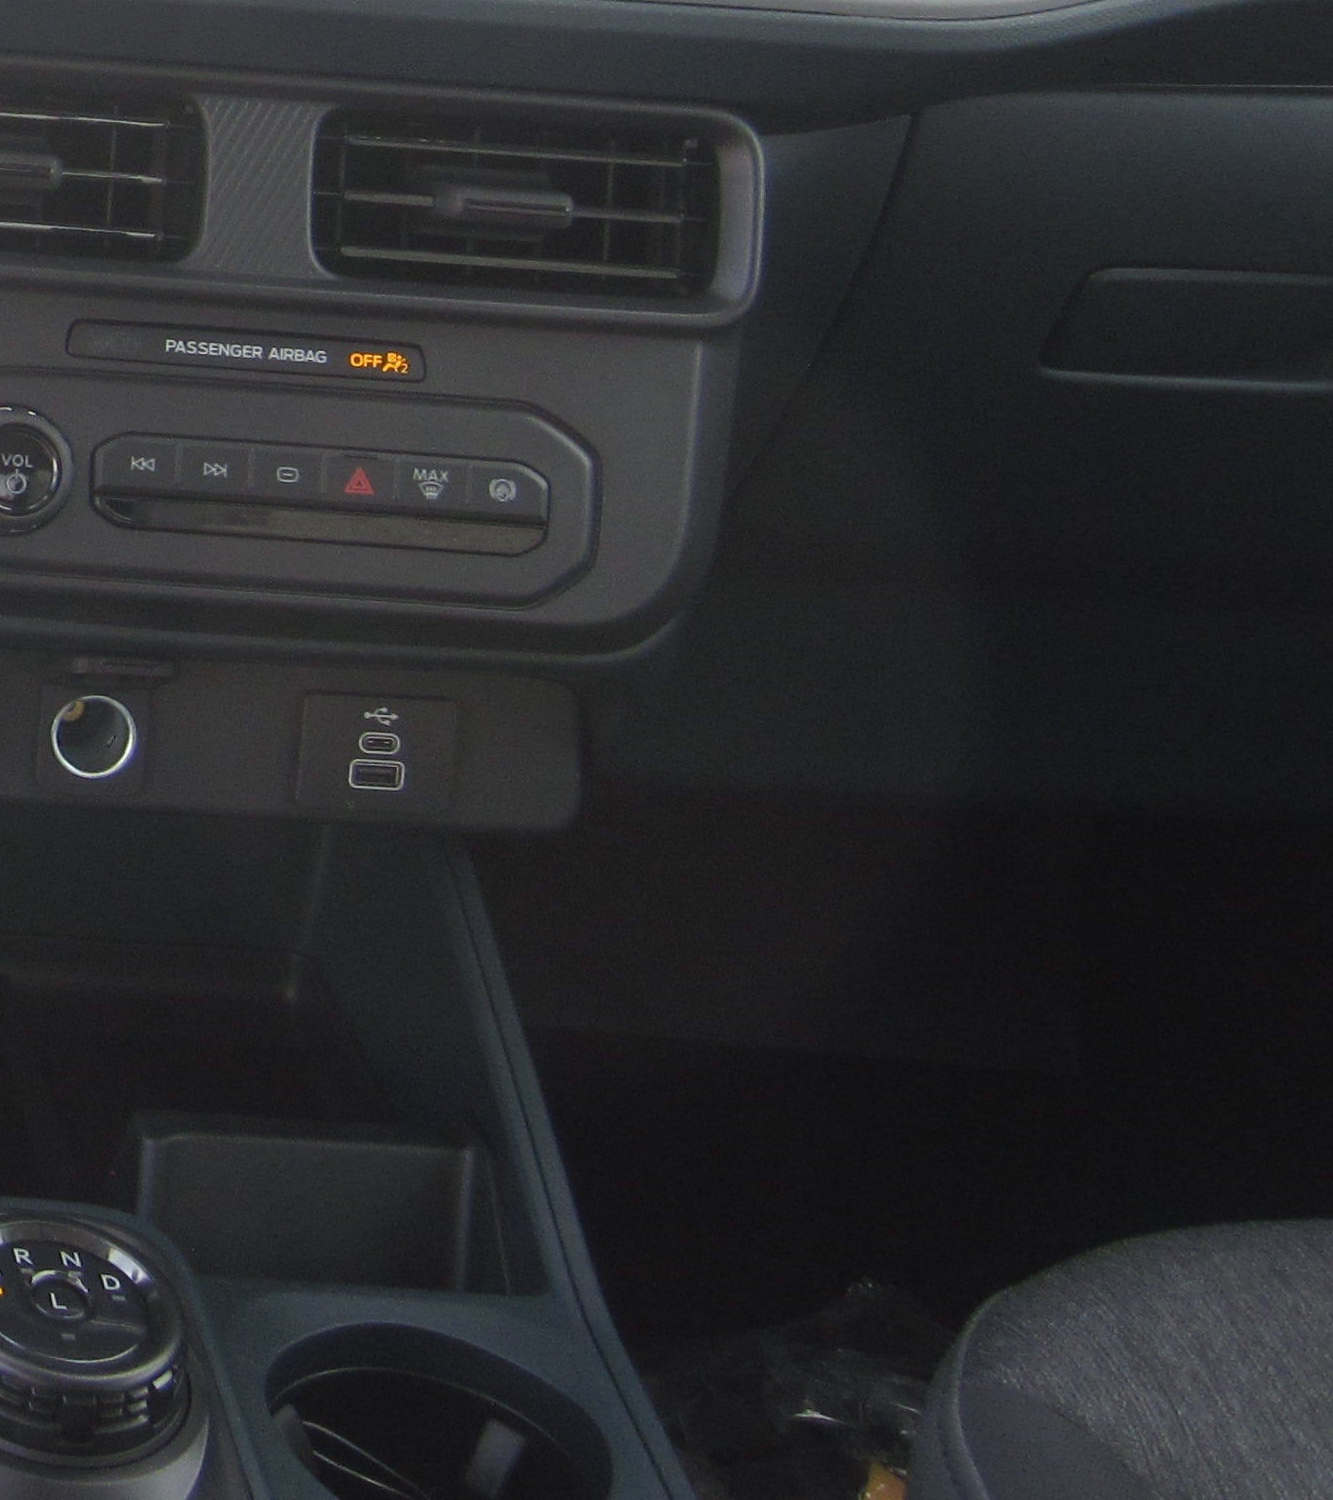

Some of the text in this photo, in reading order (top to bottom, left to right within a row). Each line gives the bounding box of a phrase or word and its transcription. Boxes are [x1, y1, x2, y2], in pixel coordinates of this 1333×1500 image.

[165, 338, 328, 364] PASSENGER AIRBAG
[349, 352, 382, 368] OFF
[1, 454, 34, 469] VOL
[413, 467, 450, 482] MAX
[14, 1247, 33, 1264] R
[60, 1252, 82, 1268] N
[100, 1274, 120, 1290] D
[50, 1292, 68, 1311] L
